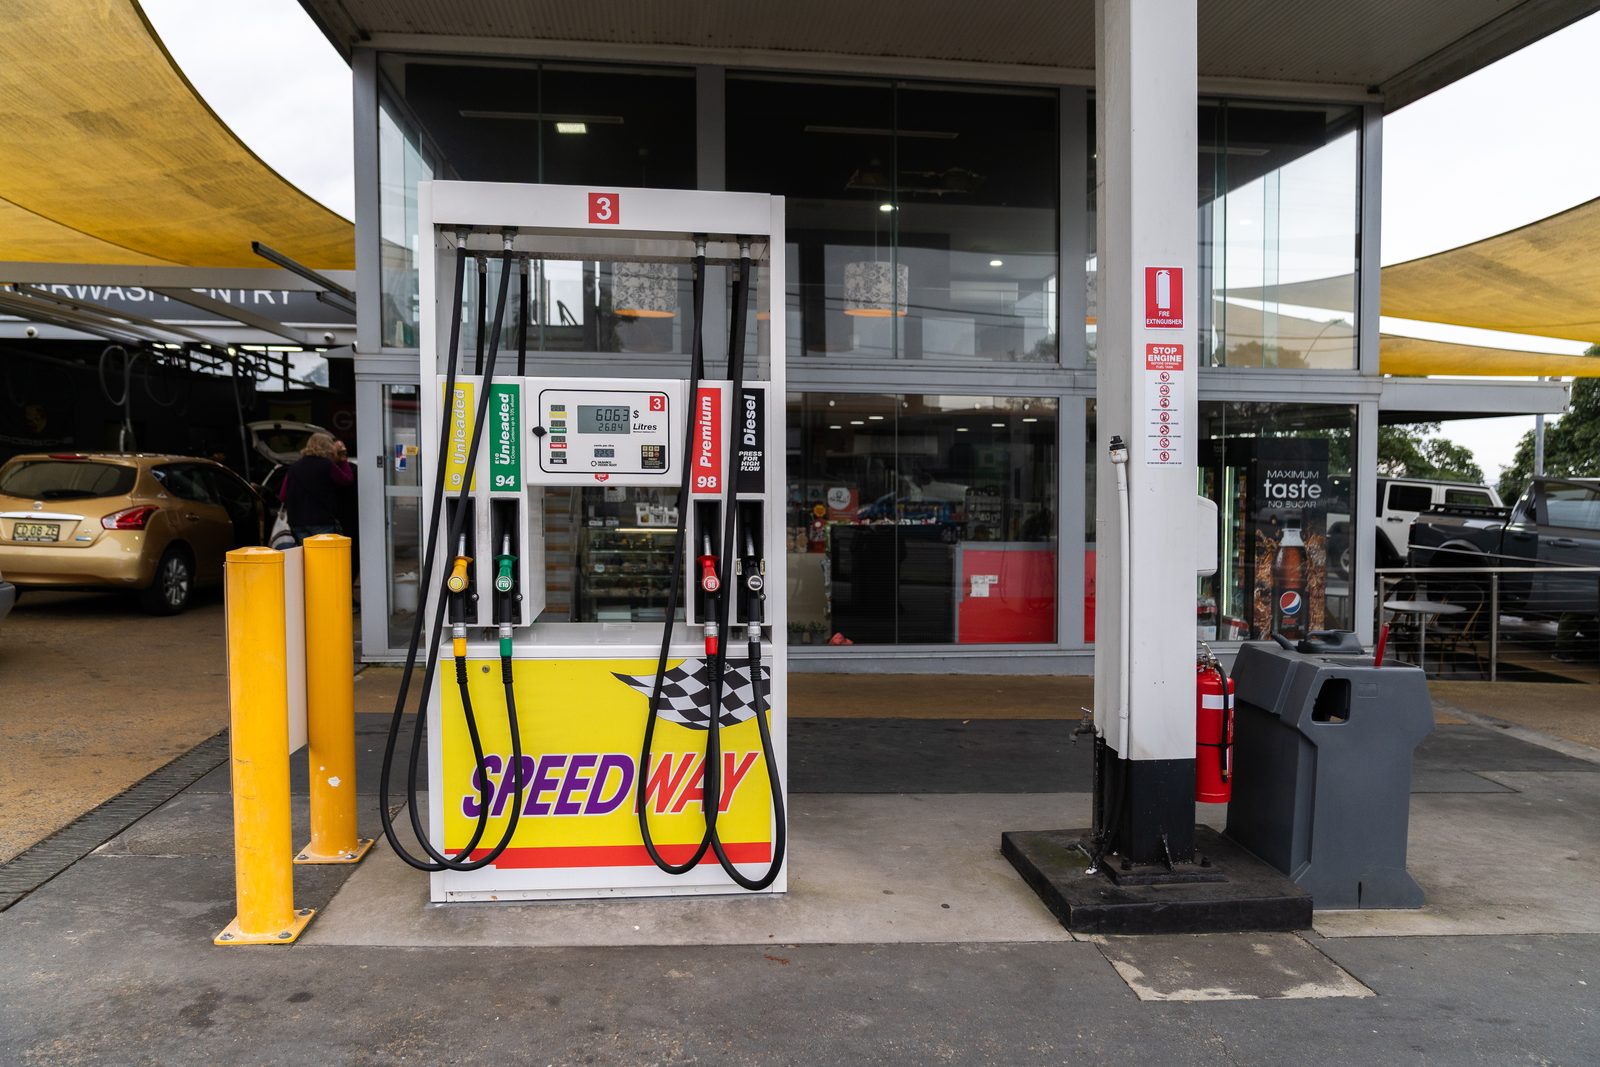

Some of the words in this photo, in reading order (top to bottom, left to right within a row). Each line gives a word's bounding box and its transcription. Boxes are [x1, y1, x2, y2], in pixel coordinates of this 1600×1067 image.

[596, 197, 612, 220] 3
[1152, 346, 1177, 354] STOP
[1147, 354, 1182, 362] ENGINE
[653, 397, 662, 410] 3
[632, 409, 640, 419] $
[743, 394, 756, 446] Diesel
[453, 389, 466, 465] Unleaded
[499, 393, 511, 465] Unleaded
[598, 422, 624, 432] 26.84
[632, 423, 657, 431] Litres
[699, 396, 712, 468] Premium
[495, 474, 515, 487] 94
[1267, 470, 1319, 479] MAXIMUM
[697, 475, 717, 488] 98
[1263, 478, 1322, 499] taste
[1268, 500, 1283, 508] NO
[1285, 501, 1317, 509] SUGAR
[462, 751, 760, 818] SPEEDWAY
